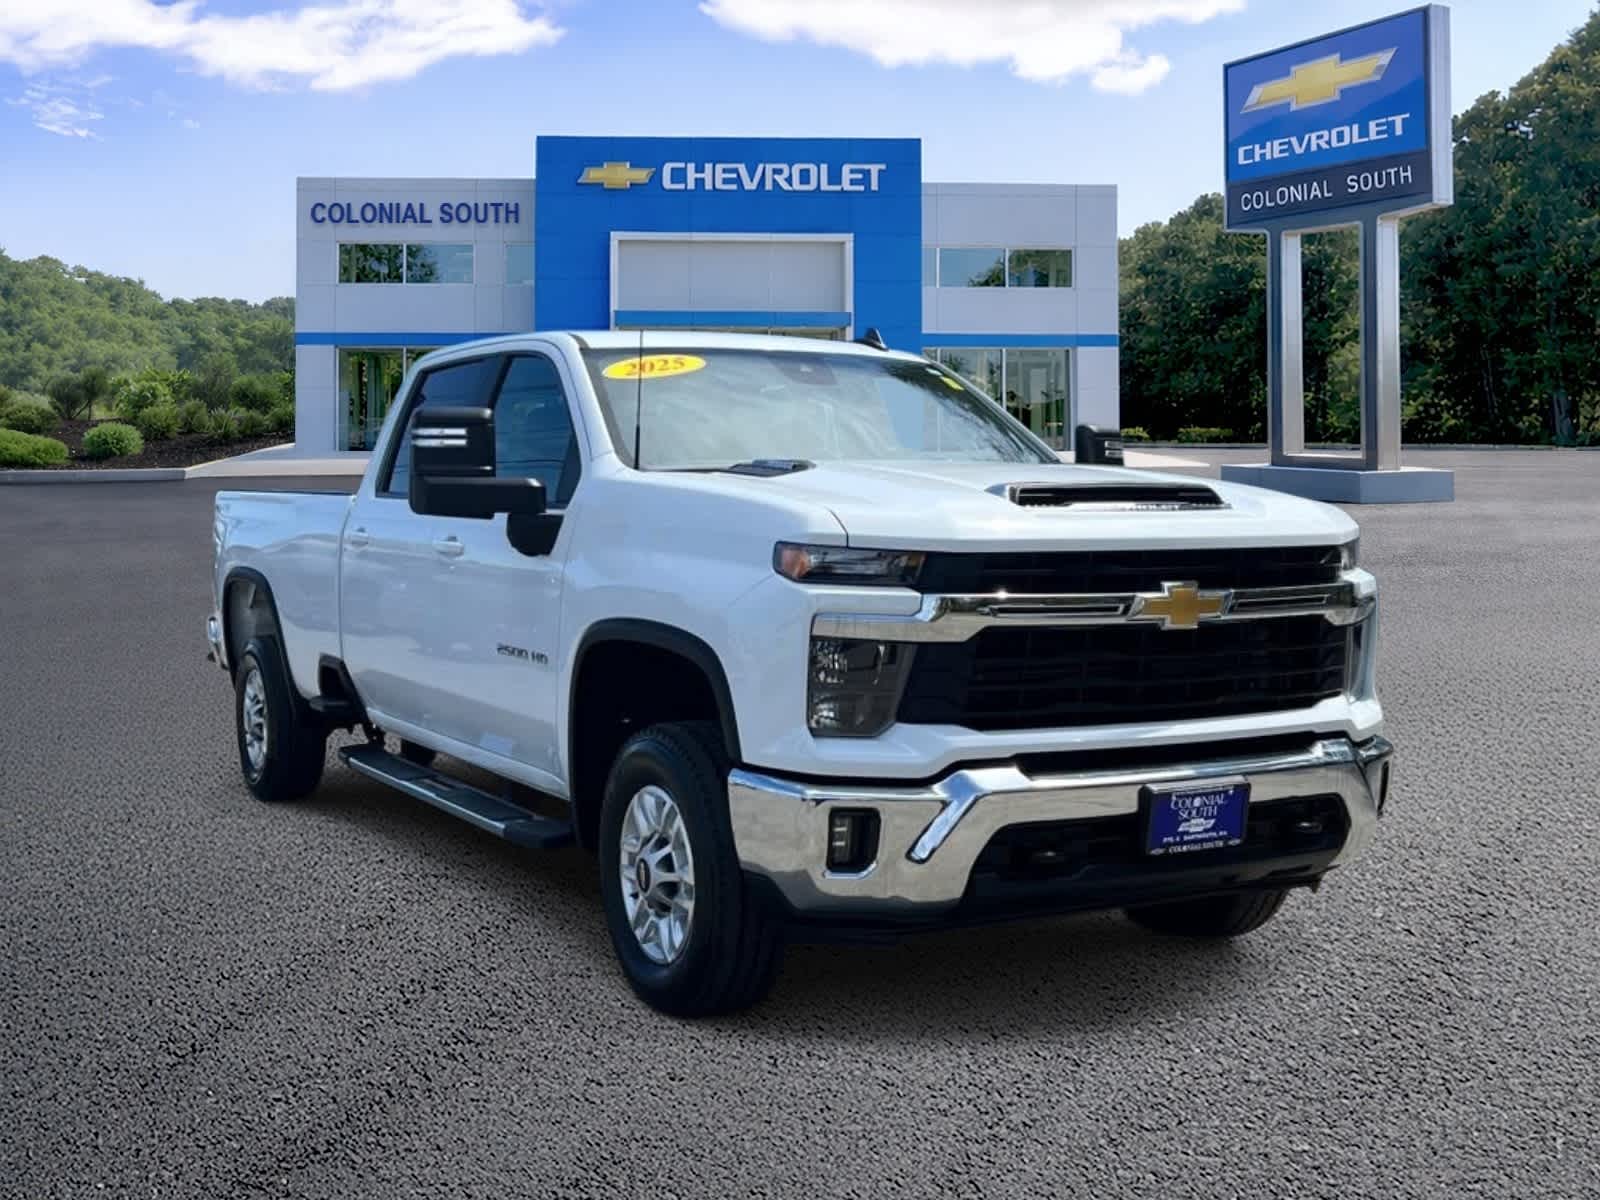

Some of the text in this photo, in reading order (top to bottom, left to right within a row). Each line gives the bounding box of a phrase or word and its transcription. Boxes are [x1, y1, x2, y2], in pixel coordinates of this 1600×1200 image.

[1237, 113, 1410, 165] CHEVROLET
[662, 161, 887, 192] CHEVROLET
[1240, 165, 1412, 211] COLONIAL SOUTH
[310, 202, 520, 224] COLONIAL SOUTH
[624, 358, 685, 376] 2025
[1170, 793, 1225, 810] COLONIAL
[1178, 805, 1218, 820] SOUTH
